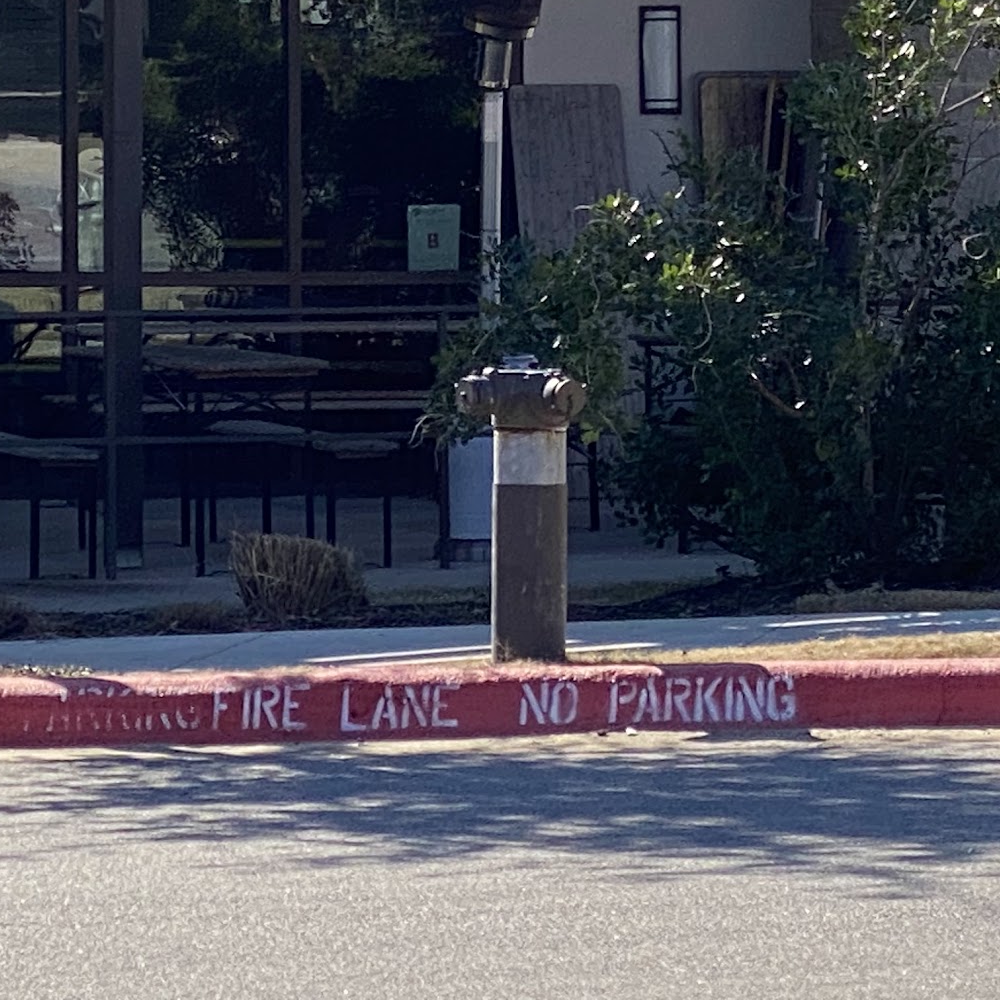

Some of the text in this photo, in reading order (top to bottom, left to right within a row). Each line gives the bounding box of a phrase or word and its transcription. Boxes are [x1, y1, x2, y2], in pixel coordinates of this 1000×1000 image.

[211, 683, 311, 731] FIRE
[340, 680, 459, 732] LANE
[519, 680, 579, 726] NO
[608, 673, 796, 724] PARKING
